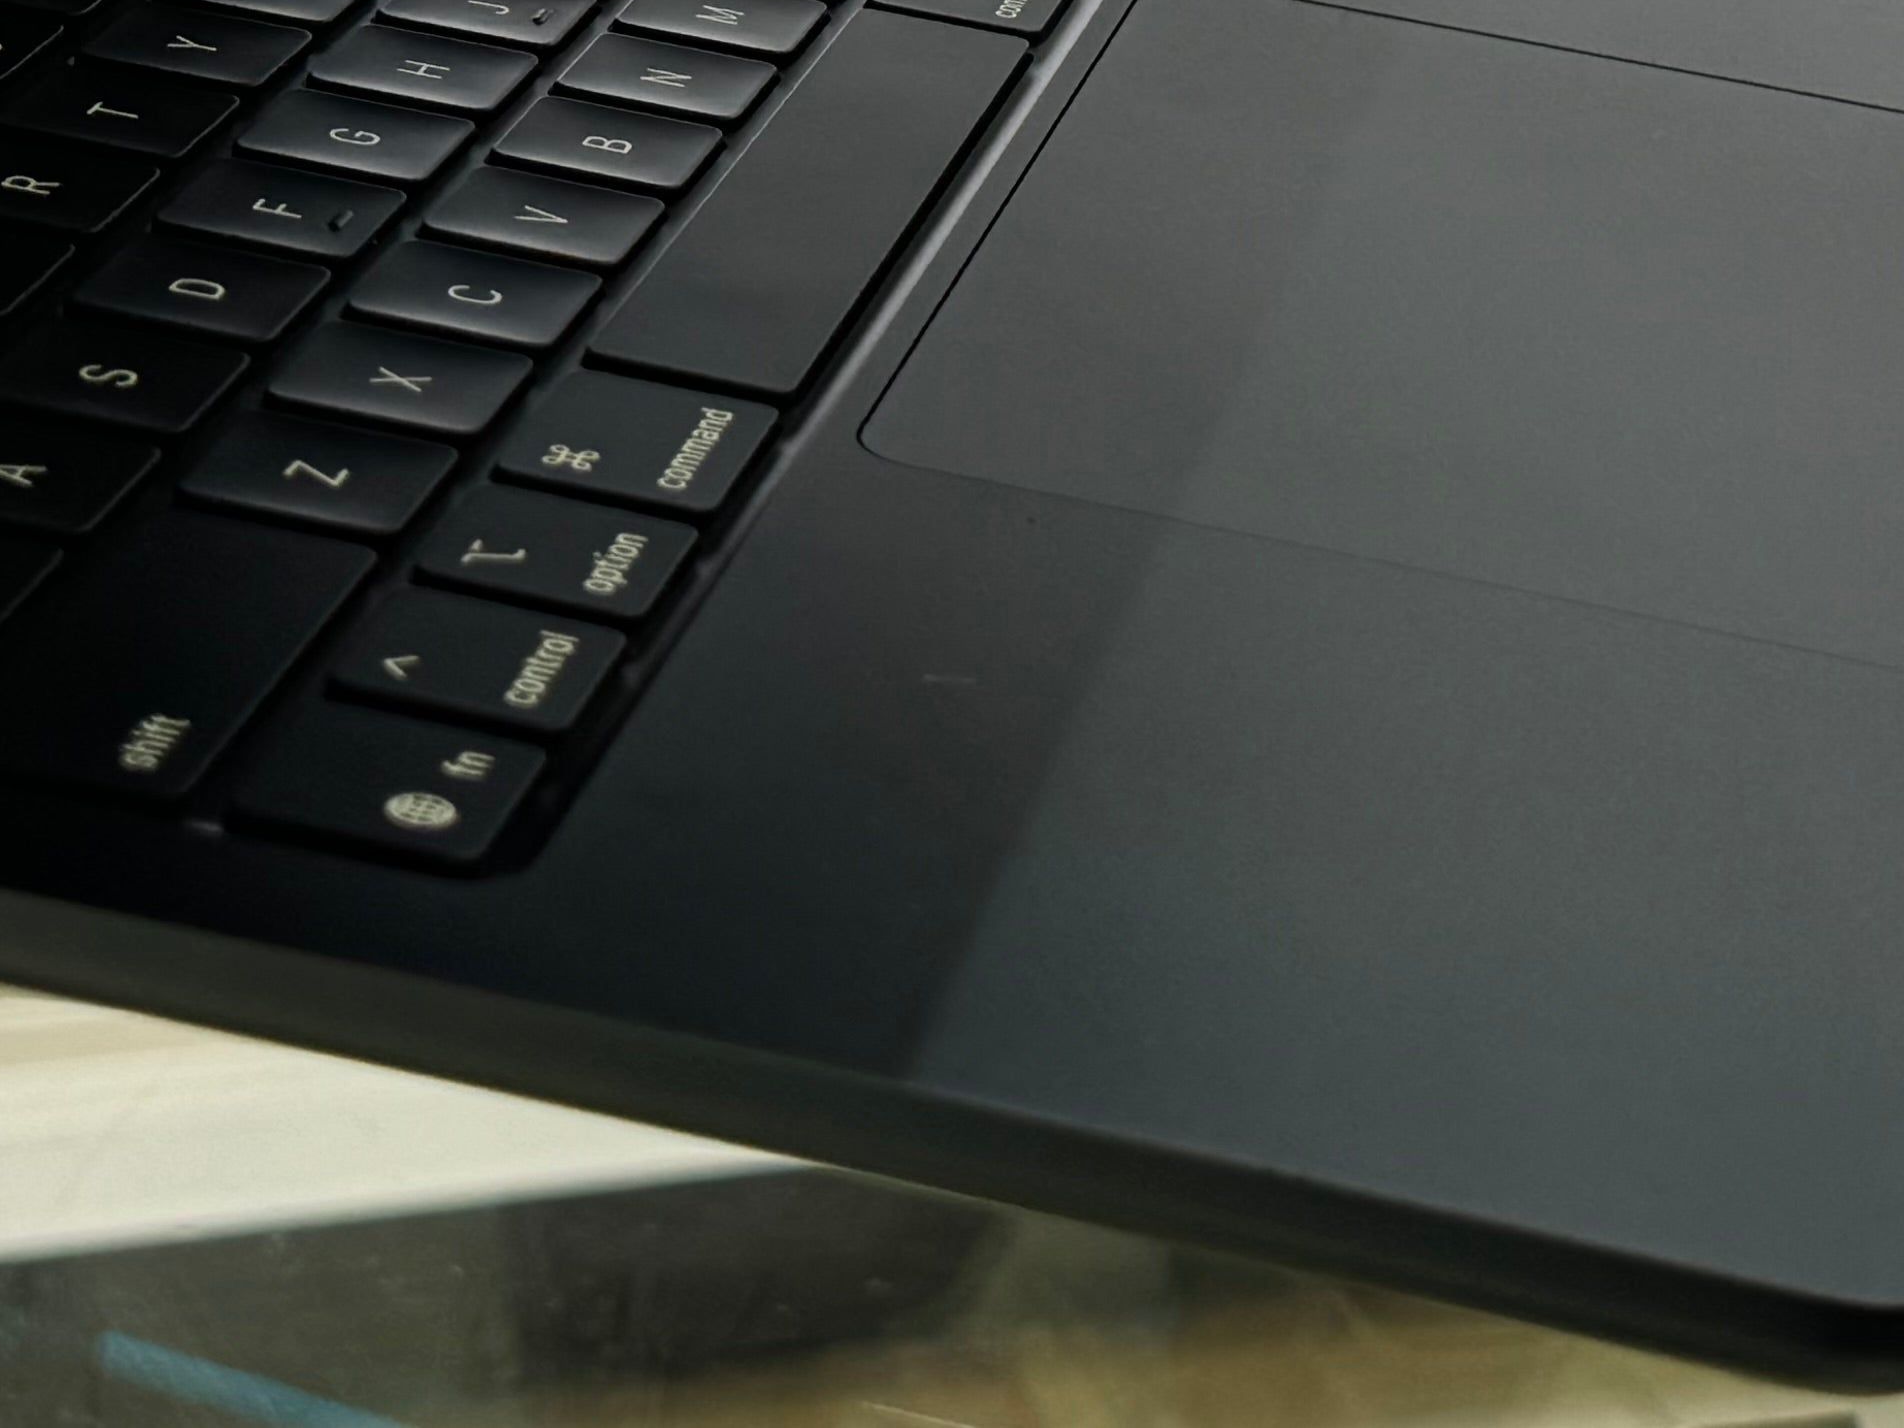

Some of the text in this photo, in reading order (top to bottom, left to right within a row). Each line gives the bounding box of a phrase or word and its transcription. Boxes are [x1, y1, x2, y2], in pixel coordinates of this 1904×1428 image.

[467, 0, 510, 15] J
[695, 4, 745, 25] M
[167, 35, 217, 52] Y
[396, 59, 450, 79] H
[639, 67, 692, 88] N
[86, 101, 139, 119] T
[329, 127, 381, 146] G
[582, 135, 633, 154] B
[0, 175, 60, 195] R
[252, 198, 302, 219] F
[514, 204, 569, 224] V
[168, 278, 226, 300] D
[447, 284, 503, 305] C
[78, 364, 138, 387] S
[369, 366, 433, 393] X
[657, 406, 734, 489] command
[283, 459, 349, 487] Z
[582, 532, 649, 592] option
[503, 629, 579, 705] control
[120, 714, 192, 772] shift
[442, 752, 494, 776] fn
